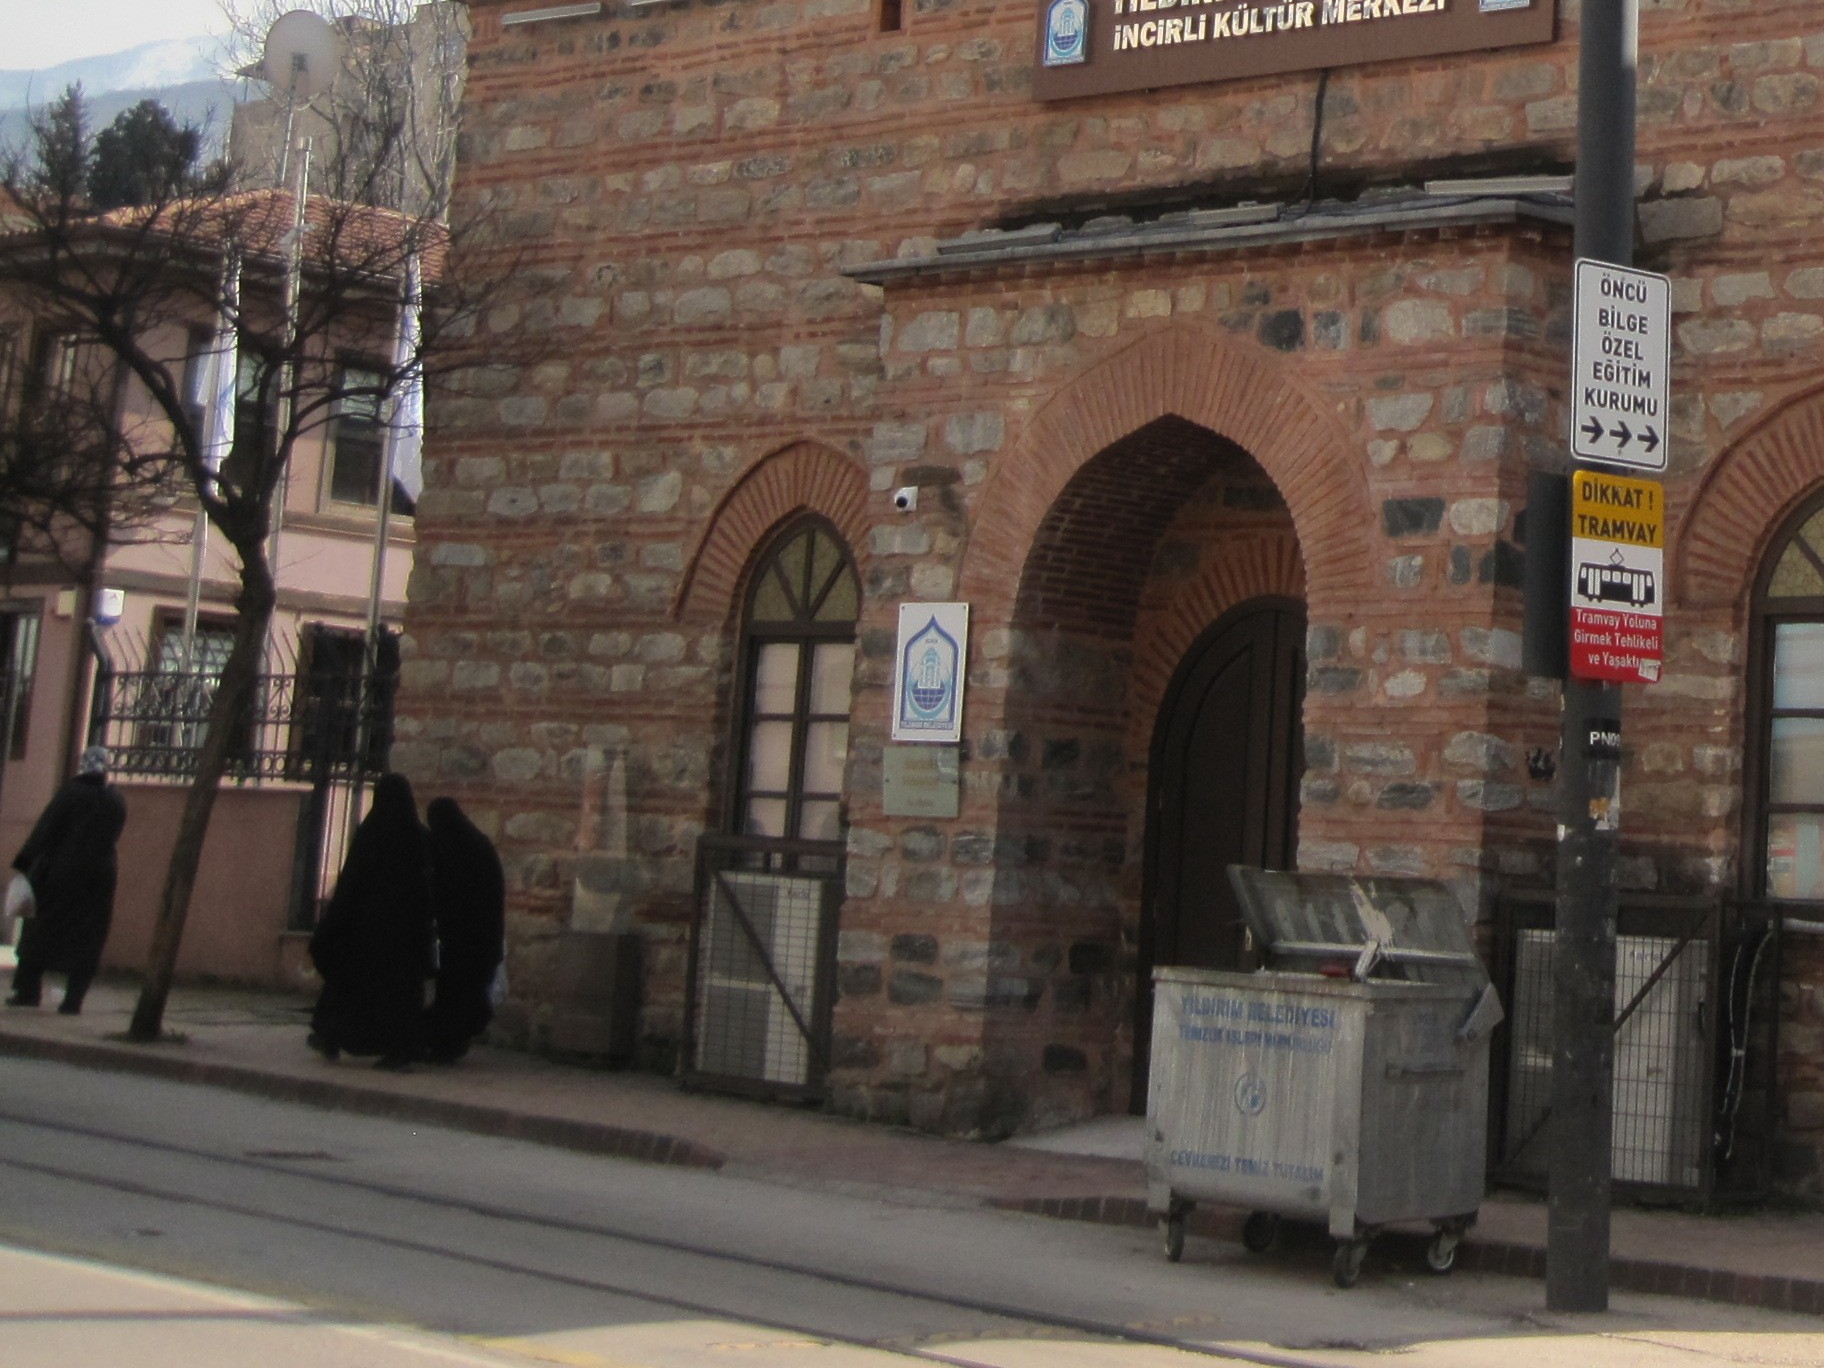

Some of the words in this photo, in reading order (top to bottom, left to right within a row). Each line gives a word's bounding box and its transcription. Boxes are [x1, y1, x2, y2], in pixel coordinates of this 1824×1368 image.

[1600, 273, 1648, 303] ÖNCÜ
[1598, 305, 1649, 334] BİLGE
[1601, 332, 1644, 360] ÖZEL
[1593, 360, 1651, 388] EĞİTİM
[1584, 387, 1658, 417] KURUMU
[1582, 479, 1643, 508] DİKKAT
[1578, 514, 1657, 543] TRAMVAY
[1576, 609, 1621, 630] Tramvay
[1622, 613, 1657, 631] Yoluna
[1574, 629, 1612, 647] Girmek
[1615, 632, 1659, 650] Tehlikeli
[1588, 654, 1600, 665] ve
